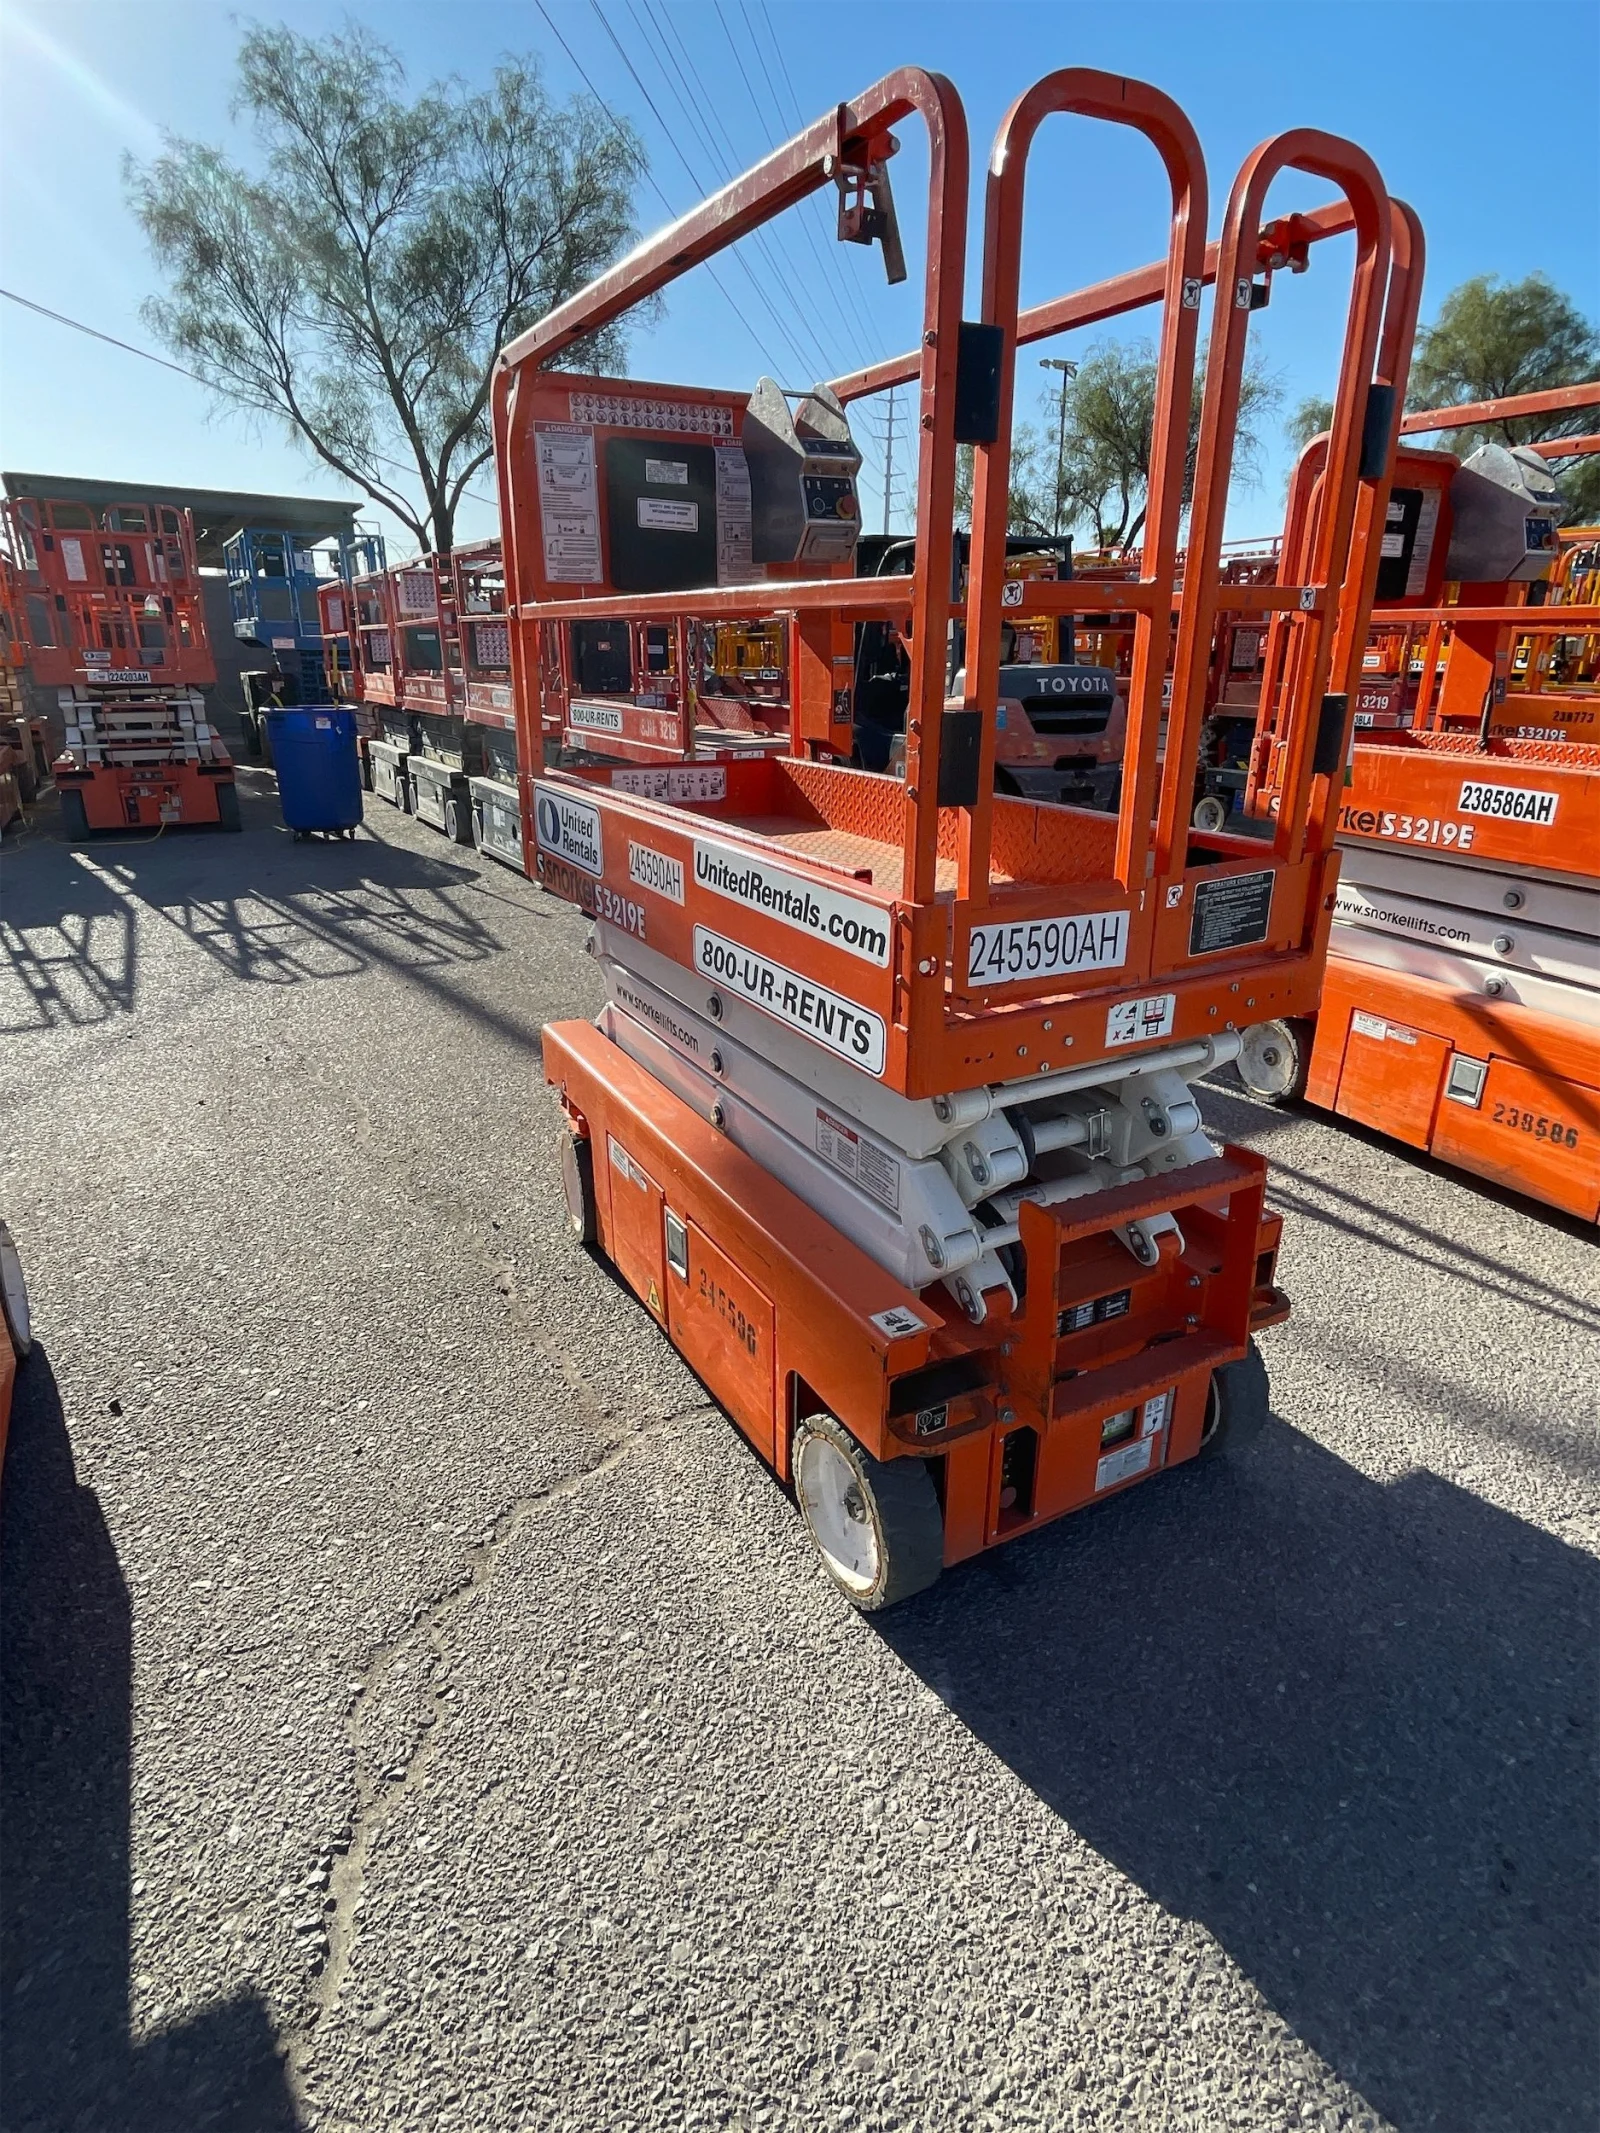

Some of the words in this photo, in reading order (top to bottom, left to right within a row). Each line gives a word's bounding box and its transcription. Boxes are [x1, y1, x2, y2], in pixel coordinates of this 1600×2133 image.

[1036, 677, 1109, 693] TOYOTA
[1361, 694, 1389, 710] 3219
[660, 720, 677, 741] 3219
[1517, 726, 1567, 742] S3219E
[560, 806, 594, 840] United
[1459, 785, 1554, 823] 238586AH
[562, 830, 599, 866] Rentals
[1381, 812, 1475, 850] S3219E
[628, 843, 682, 900] 245590AH
[594, 883, 647, 941] S3219E
[696, 851, 887, 959] UnitedRentals.com
[968, 916, 1120, 978] 245590AH
[702, 939, 872, 1055] 800-UR-RENTS
[615, 982, 699, 1053] www.snorkellifts.com
[1492, 1103, 1579, 1149] 238586
